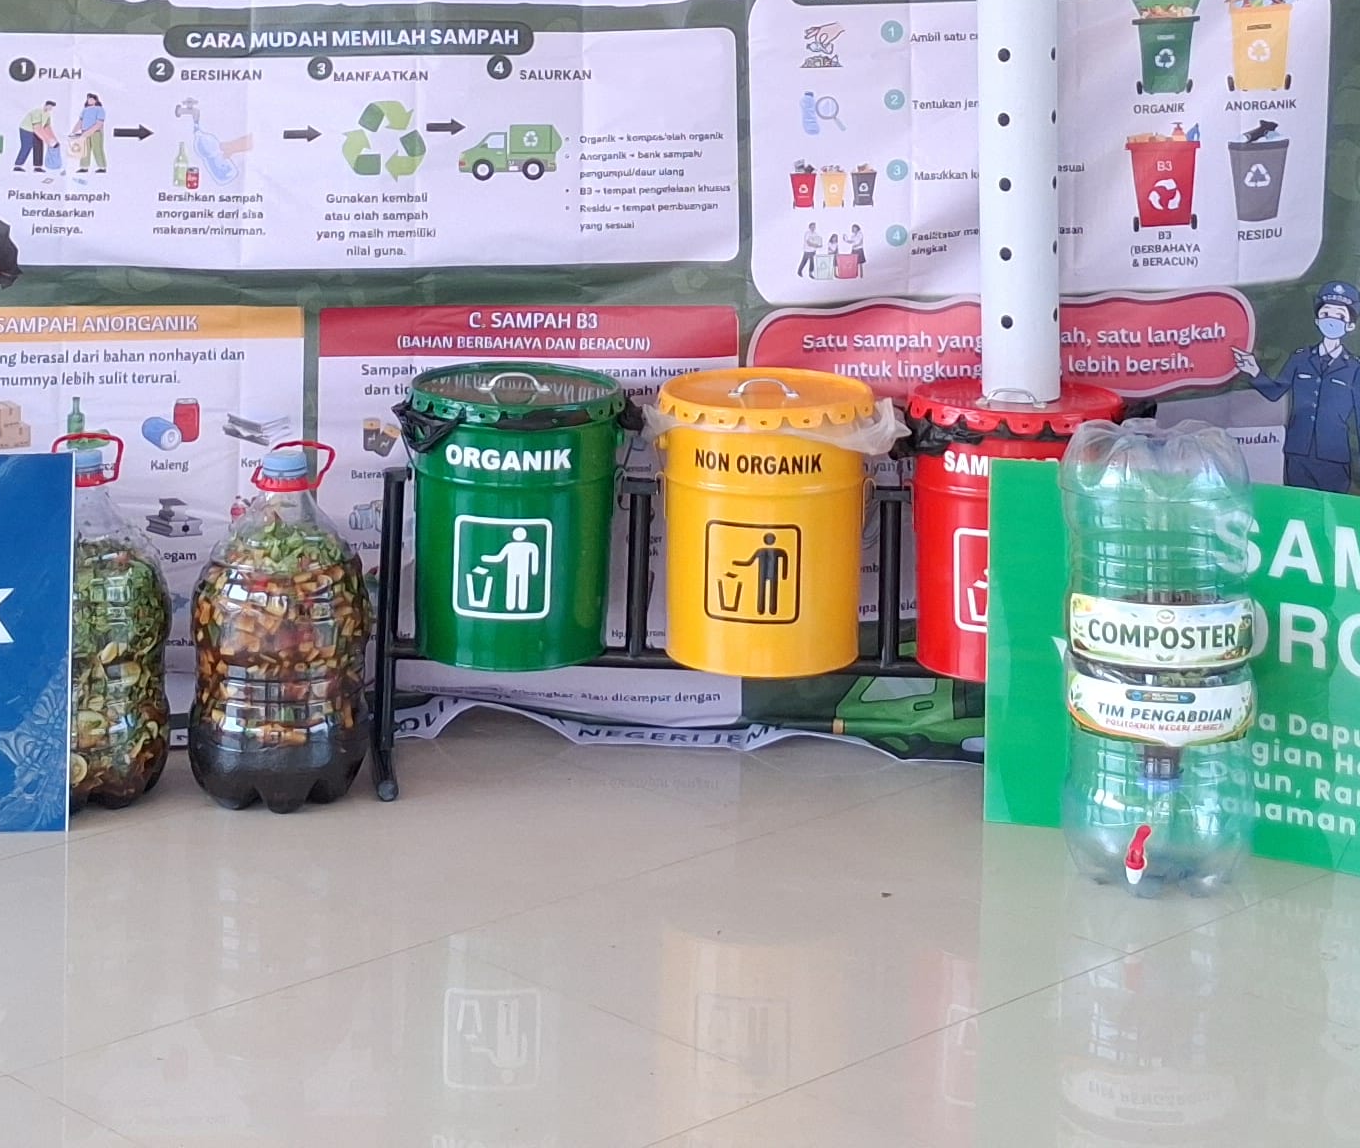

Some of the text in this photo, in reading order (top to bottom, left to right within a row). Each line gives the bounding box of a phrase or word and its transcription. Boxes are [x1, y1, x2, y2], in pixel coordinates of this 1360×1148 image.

[186, 28, 519, 49] CARA MUDAH MEMILAH SAMPAH
[910, 32, 942, 43] Ambil
[944, 33, 968, 42] satu
[19, 62, 82, 80] 1 PILAH
[155, 63, 263, 82] 2 BERSIHKAN
[315, 62, 429, 82] 3 MANFAATKAN
[493, 61, 592, 81] 4 SALURKAN
[912, 100, 962, 110] Tentukan
[1133, 102, 1185, 115] ORGANIK
[1224, 99, 1297, 112] ANORGANIK
[1156, 160, 1172, 172] B3
[914, 170, 968, 181] Masukkan
[7, 189, 111, 205] Pisahkan sampah
[22, 207, 95, 219] berdasarkan
[30, 224, 83, 236] jenisnya.
[1158, 230, 1172, 240] B3
[1237, 228, 1282, 241] RESIDU
[911, 243, 947, 256] singkat
[1130, 243, 1201, 256] (BERBAHAYA
[1132, 256, 1199, 268] & BERACUN)
[80, 314, 199, 334] ANORGANIK
[469, 312, 598, 330] C. SAMPAH B3
[396, 334, 650, 353] (BAHAN BERBAHAYA DAN BERACUN)
[801, 332, 983, 356] Satu sampah yang
[1096, 322, 1226, 349] satu langkah
[21, 349, 69, 365] berasal
[73, 349, 100, 365] dari
[103, 348, 144, 365] bahan
[149, 347, 218, 365] nonhayati
[221, 347, 246, 362] dan
[1067, 352, 1194, 374] lebih bersih.
[834, 359, 893, 379] untuk
[150, 459, 189, 472] Kaleng
[446, 444, 572, 471] ORGANIK
[695, 448, 822, 474] NON ORGANIK
[1088, 618, 1237, 650] COMPOSTER
[674, 692, 721, 704] dengan
[1097, 702, 1232, 723] TIM PENGABDIAN
[577, 727, 700, 743] NEGERI
